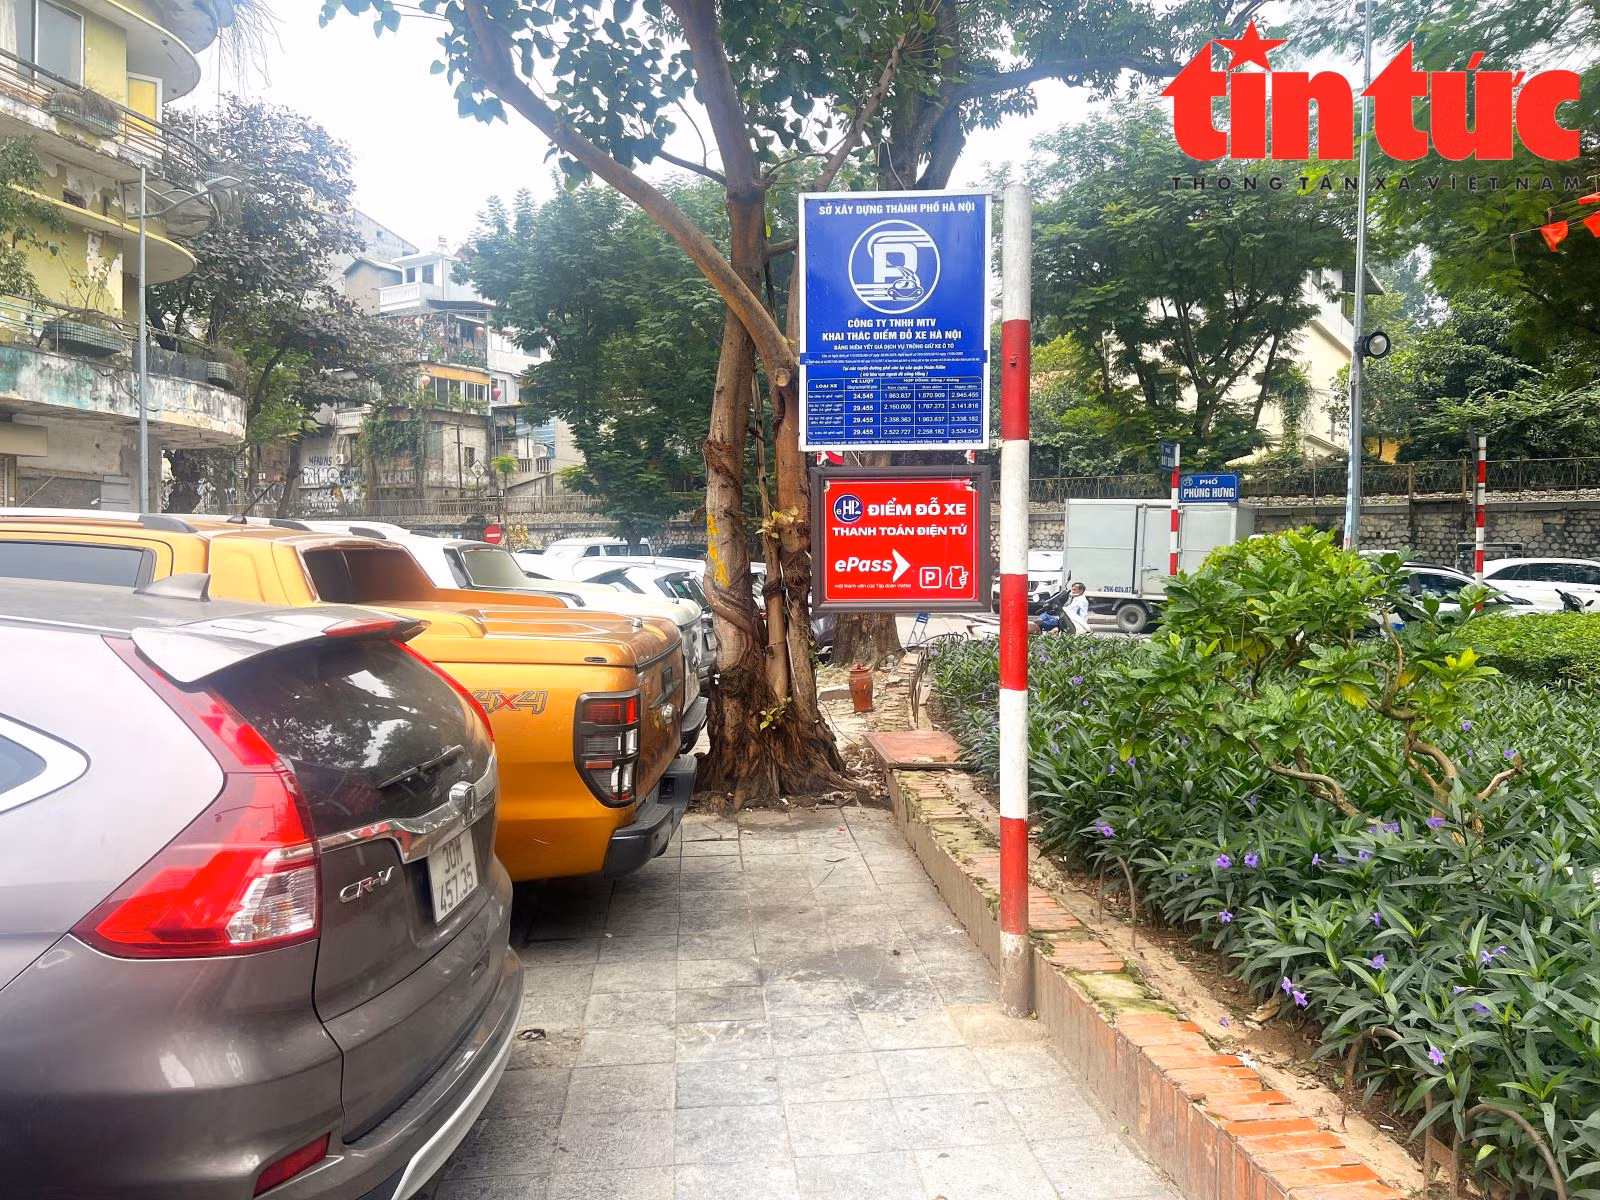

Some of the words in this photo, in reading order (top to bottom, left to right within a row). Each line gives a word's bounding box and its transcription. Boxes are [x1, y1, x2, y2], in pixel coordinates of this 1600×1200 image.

[819, 203, 832, 215] SỞ
[835, 204, 853, 214] XÂY
[856, 203, 883, 215] DỰNG
[886, 202, 917, 214] THÀNH
[920, 200, 939, 213] PHỐ
[942, 201, 956, 212] HÀ
[958, 201, 975, 213] NỘI
[848, 318, 873, 328] CÔNG
[876, 319, 887, 328] TY
[889, 318, 914, 327] TNHH
[916, 318, 936, 327] MTV
[822, 332, 844, 341] KHAI
[846, 330, 871, 340] THÁC
[873, 328, 897, 340] ĐIỂM
[899, 328, 912, 340] ĐỖ
[915, 331, 926, 340] XE
[930, 330, 942, 339] HÀ
[944, 330, 962, 340] NỘI
[1200, 476, 1218, 485] PHỐ
[1212, 487, 1234, 498] HƯNG
[867, 497, 912, 516] ĐIỂM
[915, 496, 941, 516] ĐỖ
[944, 503, 966, 515] XE
[832, 526, 876, 536] THANH
[879, 524, 914, 536] TOÁN
[917, 524, 947, 537] ĐIỆN
[949, 523, 967, 536] TỬ
[834, 556, 892, 572] ePass
[340, 866, 394, 903] CR-V
[441, 862, 473, 912] 457.35
